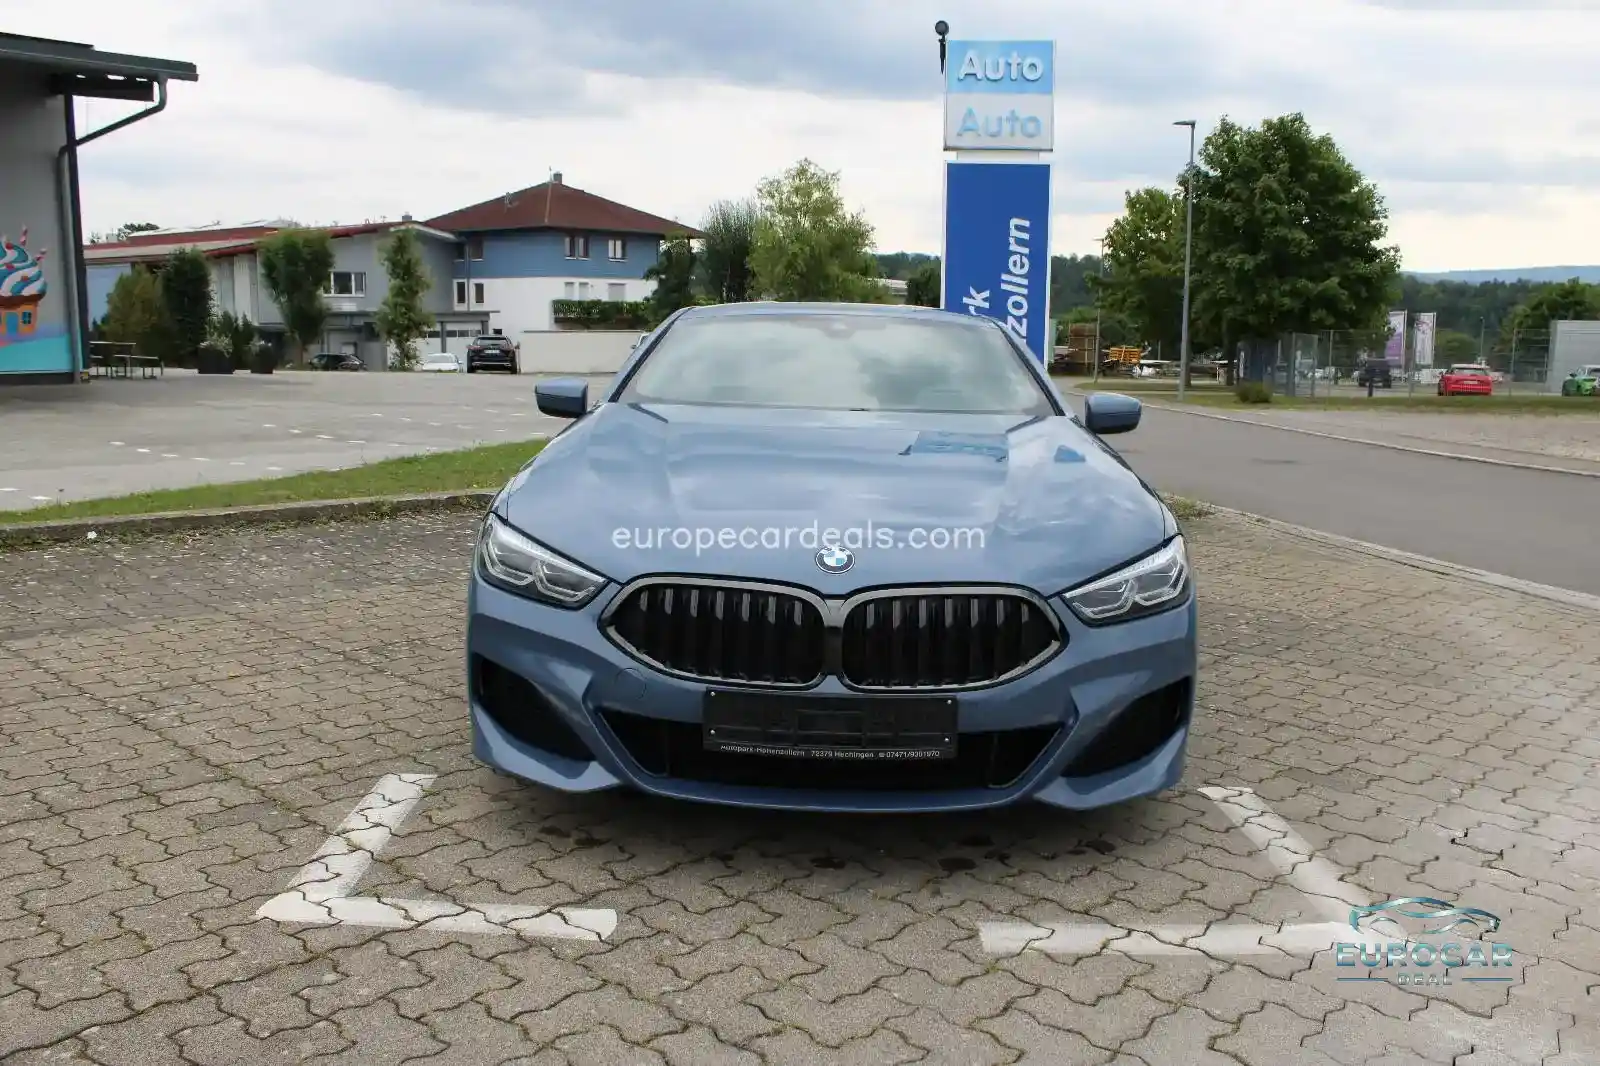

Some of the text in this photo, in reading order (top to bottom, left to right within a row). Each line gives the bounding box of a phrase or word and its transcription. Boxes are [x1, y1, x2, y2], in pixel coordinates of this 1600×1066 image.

[957, 50, 1044, 82] Auto
[957, 106, 1043, 138] Auto
[1000, 217, 1030, 344] zollern
